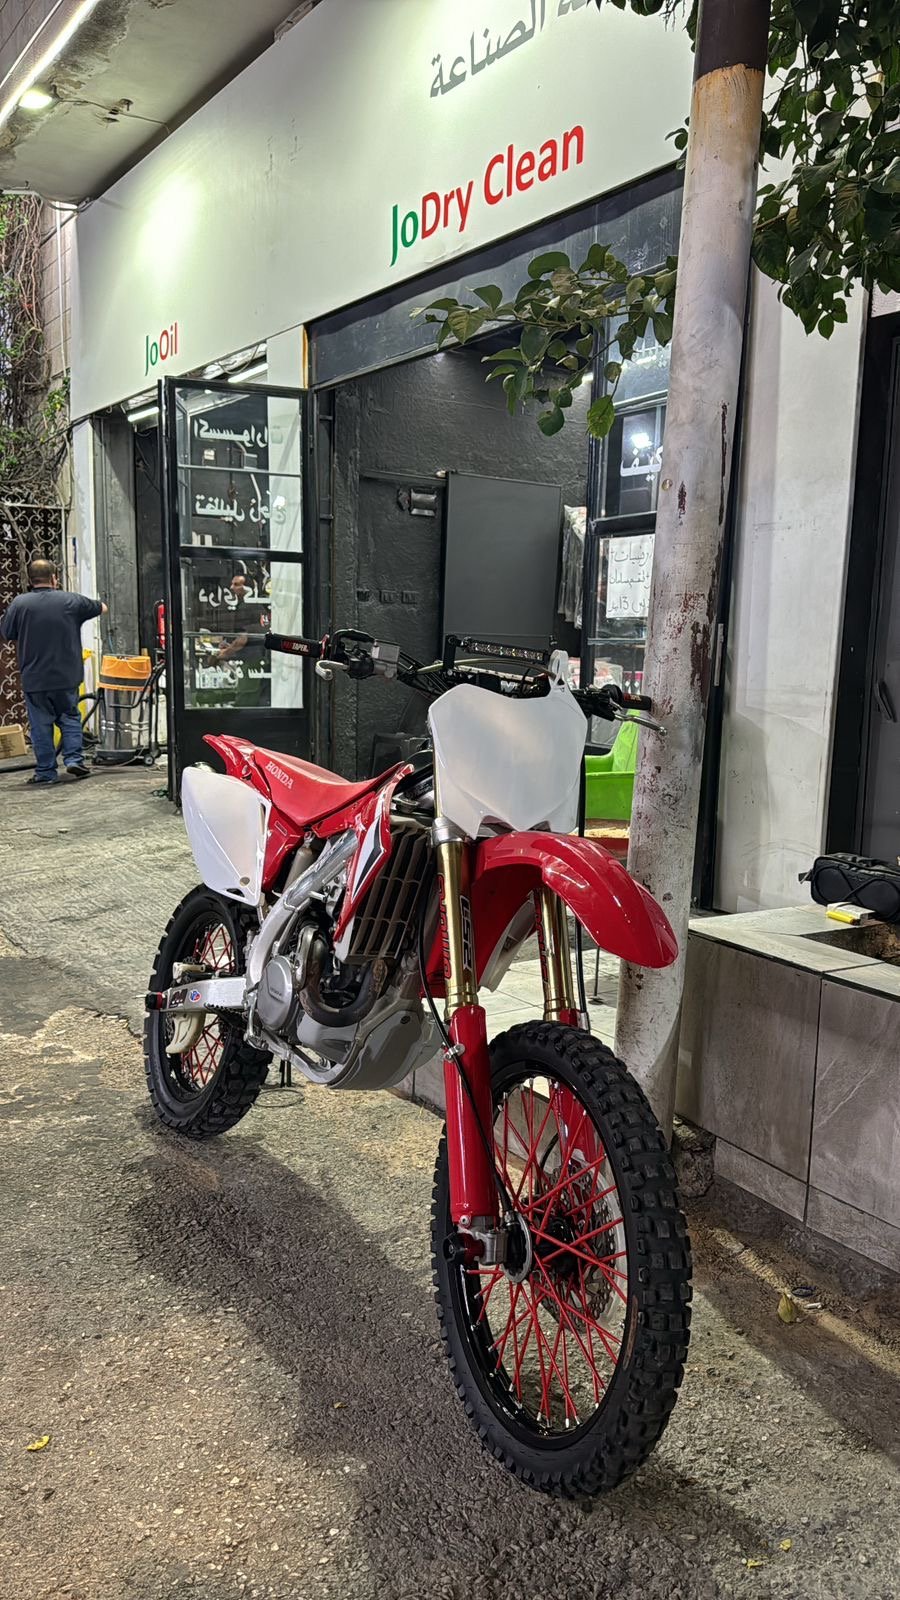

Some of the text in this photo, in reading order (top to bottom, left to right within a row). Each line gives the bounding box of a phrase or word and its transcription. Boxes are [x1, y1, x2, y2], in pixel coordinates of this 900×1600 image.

[429, 0, 547, 98] الصناعة
[389, 124, 584, 267] JoDry Clean
[144, 321, 179, 376] JoOil
[265, 761, 295, 790] HONDA
